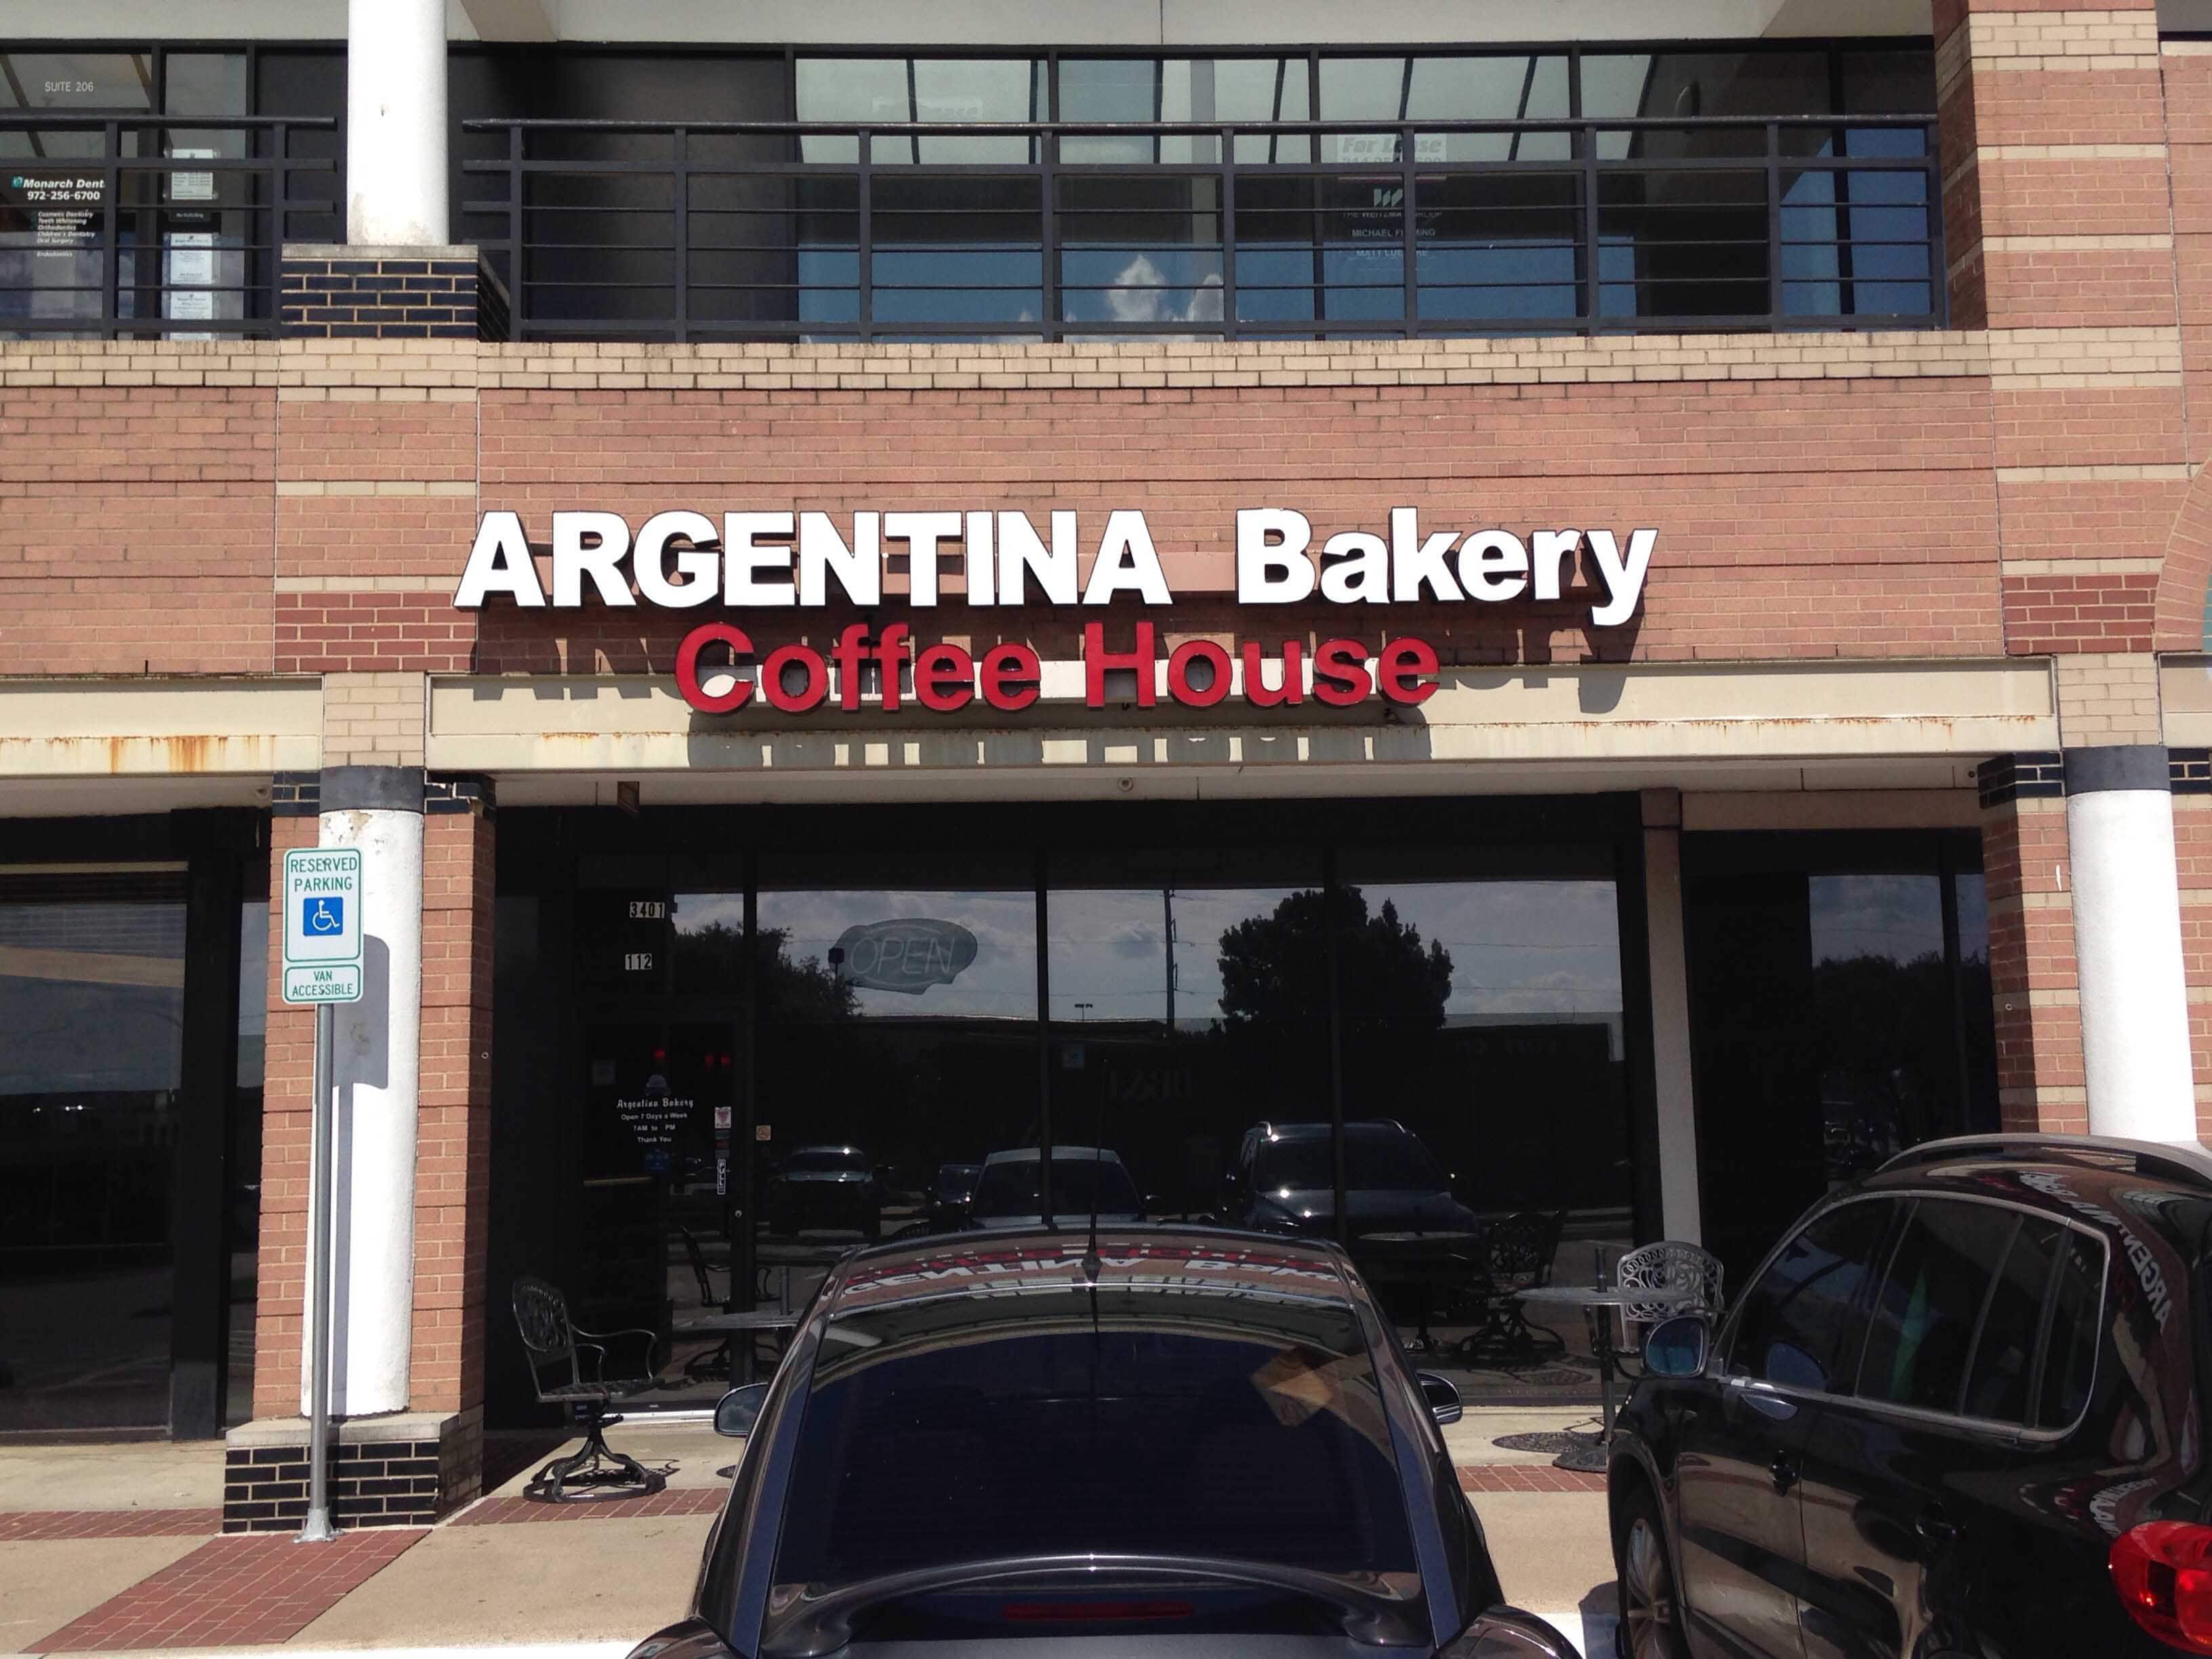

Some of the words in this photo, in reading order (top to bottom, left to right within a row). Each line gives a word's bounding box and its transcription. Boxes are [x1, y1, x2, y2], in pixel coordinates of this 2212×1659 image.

[44, 81, 70, 92] SUITE
[76, 81, 94, 92] 206
[1343, 137, 1377, 153] For
[1382, 137, 1441, 153] Lse
[23, 179, 73, 188] Monarch
[27, 191, 100, 200] 972-256-6700
[1351, 228, 1393, 237] MICHAEL
[453, 510, 1173, 610] ARGENTINA
[1236, 506, 1659, 629] Bakery
[675, 621, 1042, 714] Coffee
[1084, 620, 1441, 710] House
[290, 857, 358, 873] RESERVED
[294, 876, 352, 893] PARKING
[630, 902, 663, 918] 3401
[627, 954, 651, 969] 112
[851, 936, 955, 975] OPEN
[314, 970, 333, 982] VAN
[291, 983, 353, 997] ACCESSIBLE
[662, 1097, 693, 1108] Bakery
